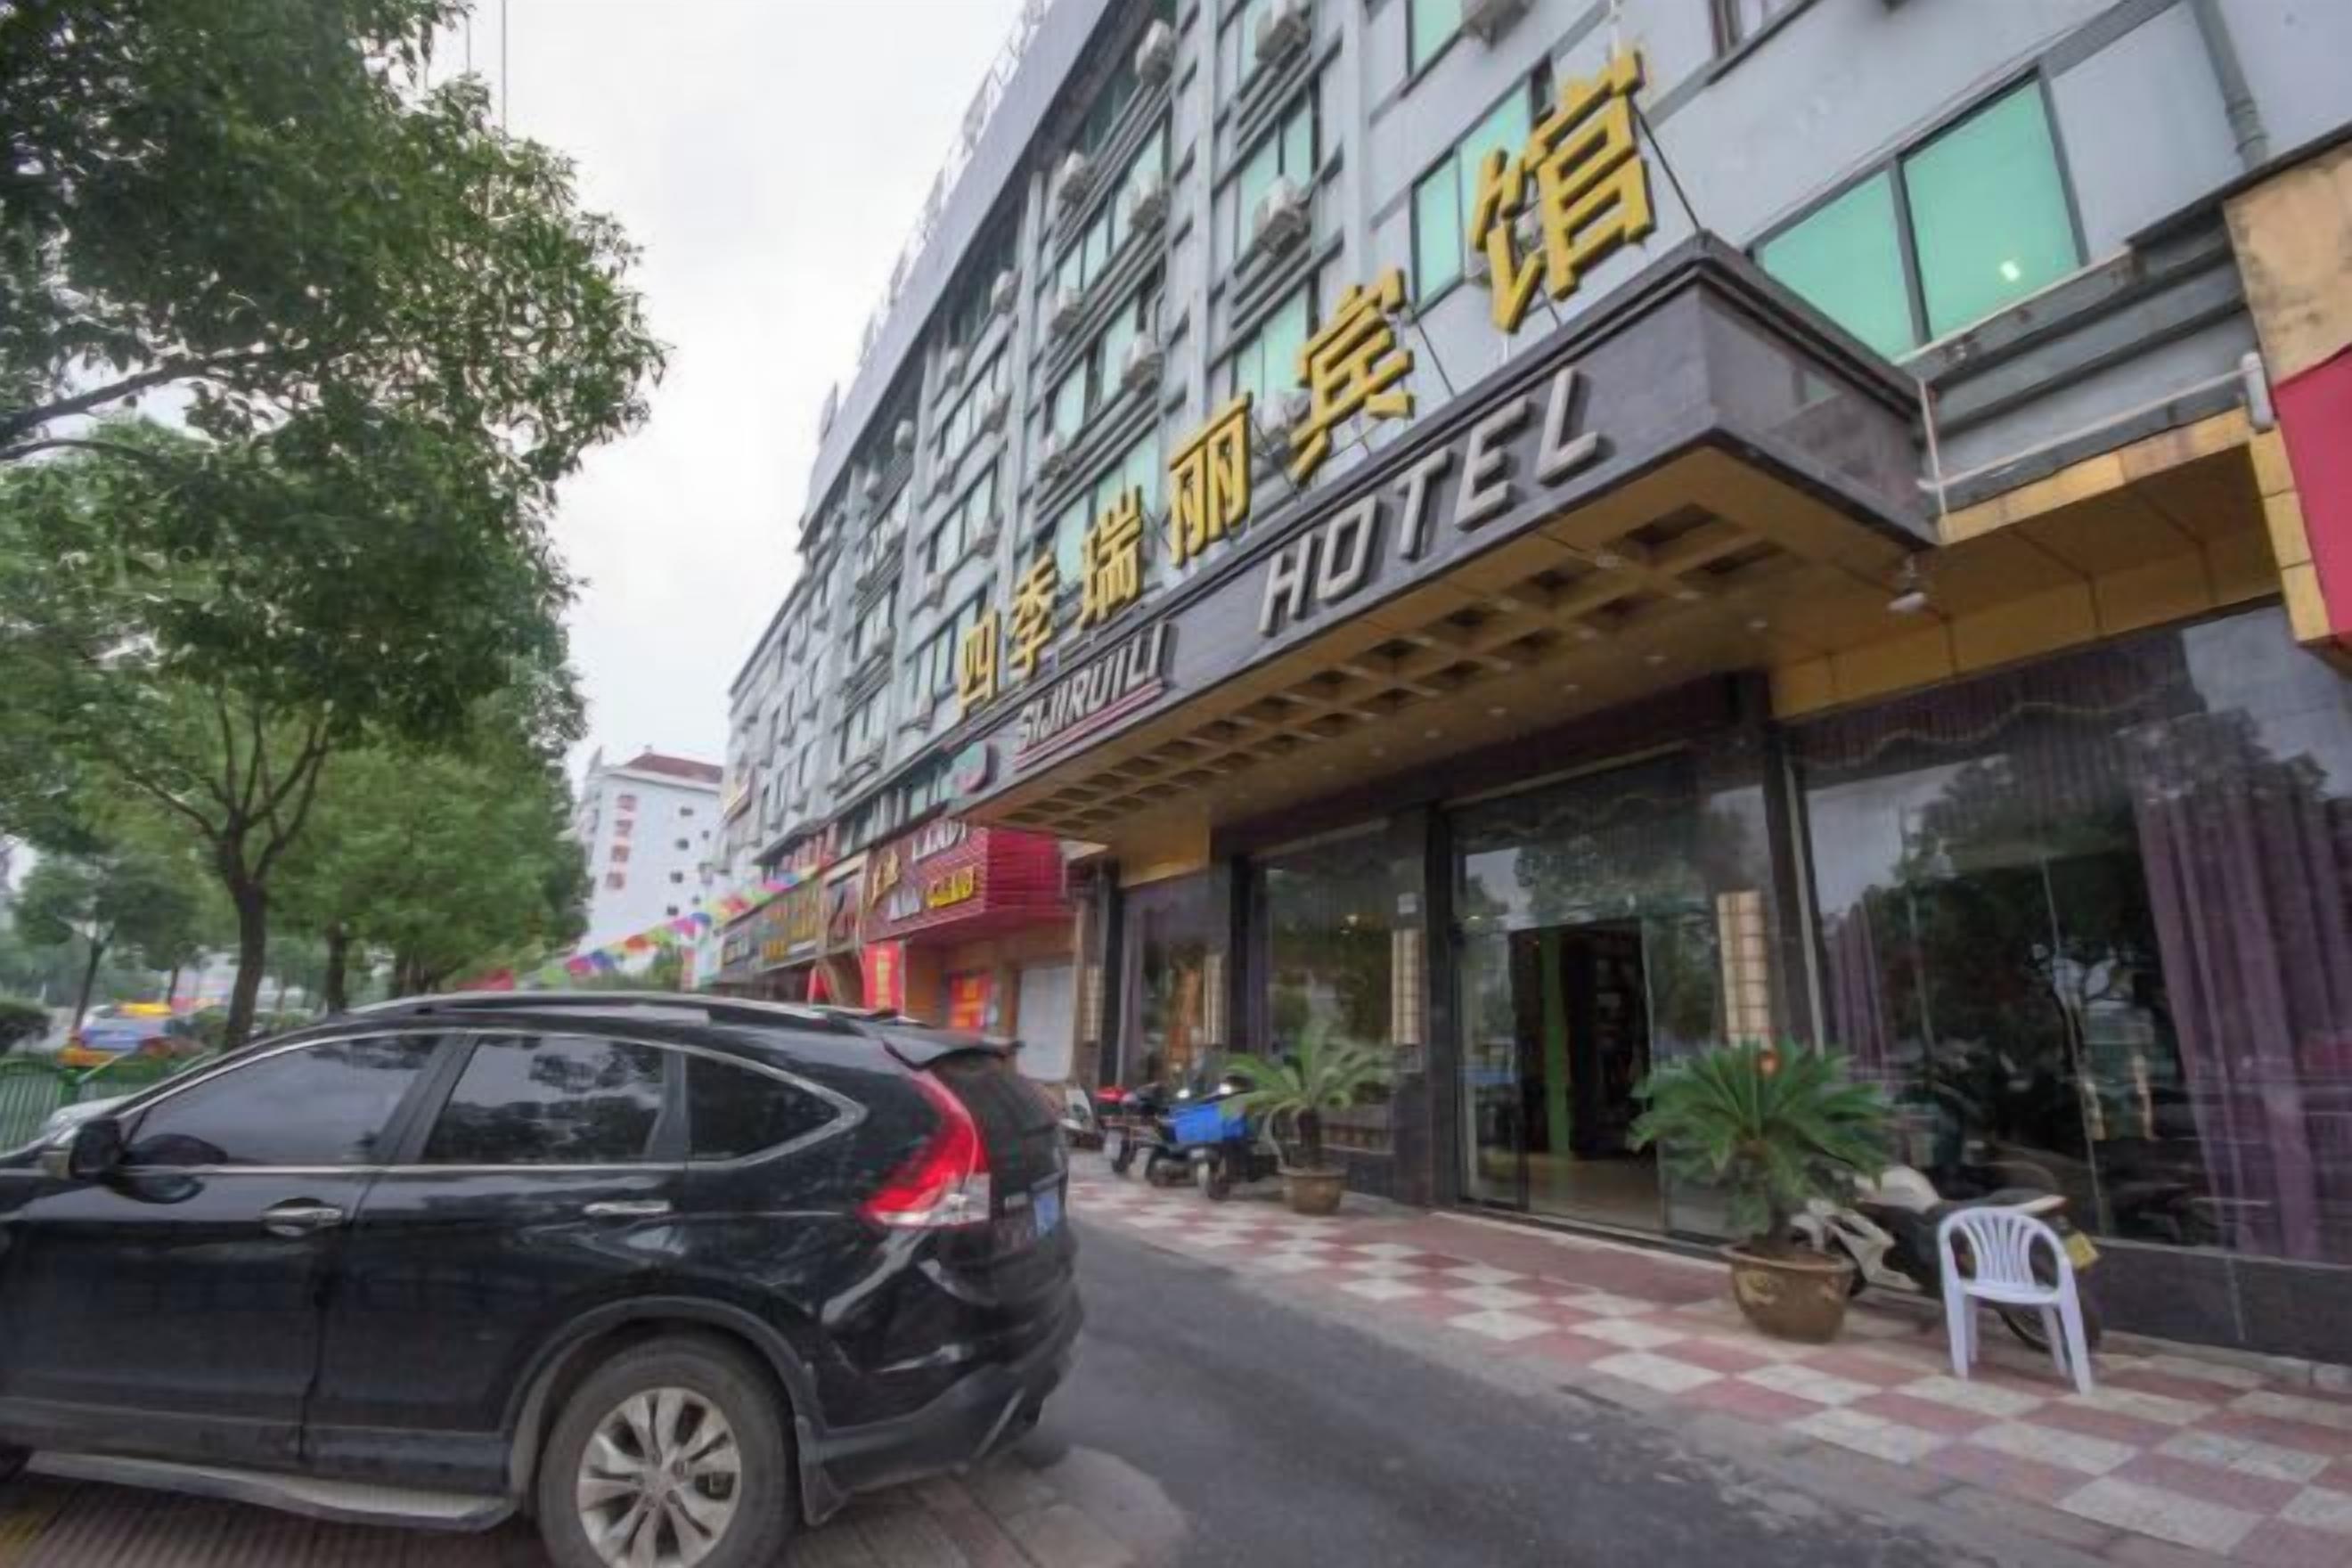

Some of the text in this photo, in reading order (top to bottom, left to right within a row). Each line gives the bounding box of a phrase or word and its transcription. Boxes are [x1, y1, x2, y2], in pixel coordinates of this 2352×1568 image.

[959, 48, 1654, 715] 四季瑞丽宾馆
[1017, 366, 1598, 749] SIJIRUILI HOTEL
